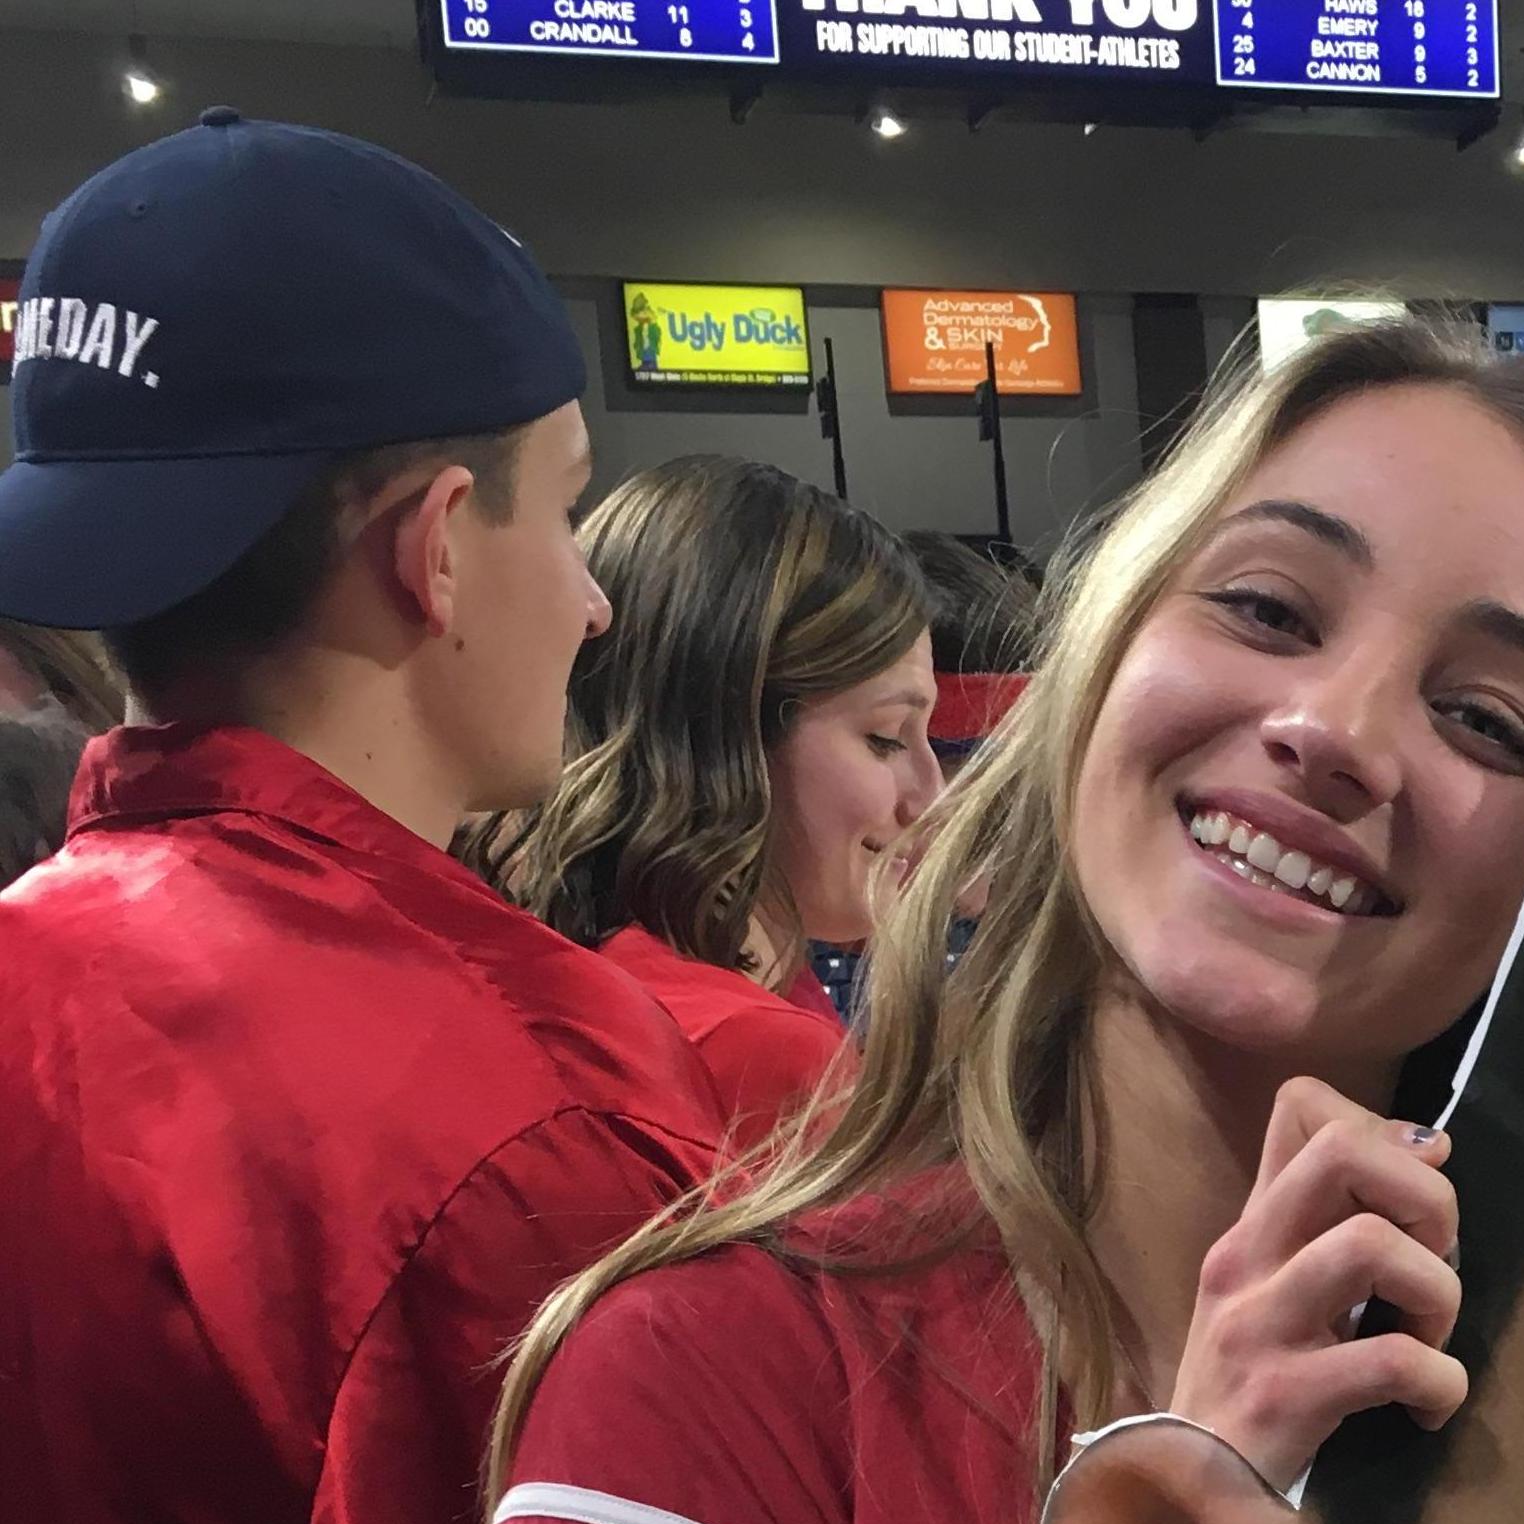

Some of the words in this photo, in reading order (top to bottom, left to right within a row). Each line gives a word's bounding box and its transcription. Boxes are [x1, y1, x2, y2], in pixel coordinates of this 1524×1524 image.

[554, 0, 636, 22] CLARKE
[667, 5, 689, 25] 11
[739, 8, 753, 28] 3
[1241, 10, 1254, 29] 4
[1317, 16, 1379, 36] EMERY
[1465, 24, 1478, 42] 2
[1465, 3, 1477, 21] 2
[464, 17, 490, 38] 00
[529, 20, 639, 46] CRANDALL
[741, 31, 755, 51] 4
[816, 20, 854, 53] FOR
[856, 22, 971, 59] SUPPORTING
[972, 29, 1012, 61] OUR
[1013, 30, 1182, 70] STUDENT-ATHLETES
[1311, 39, 1380, 60] BAXTER
[1466, 47, 1479, 65] 3
[1233, 56, 1256, 76] 24
[1306, 61, 1381, 82] CANNON
[1467, 69, 1479, 87] 2
[923, 298, 1014, 314] Advanced
[667, 312, 726, 351] Ugly
[733, 312, 802, 345] Duck
[923, 312, 1039, 332] Dermatology
[924, 326, 947, 350] &
[947, 328, 1004, 344] SKIN
